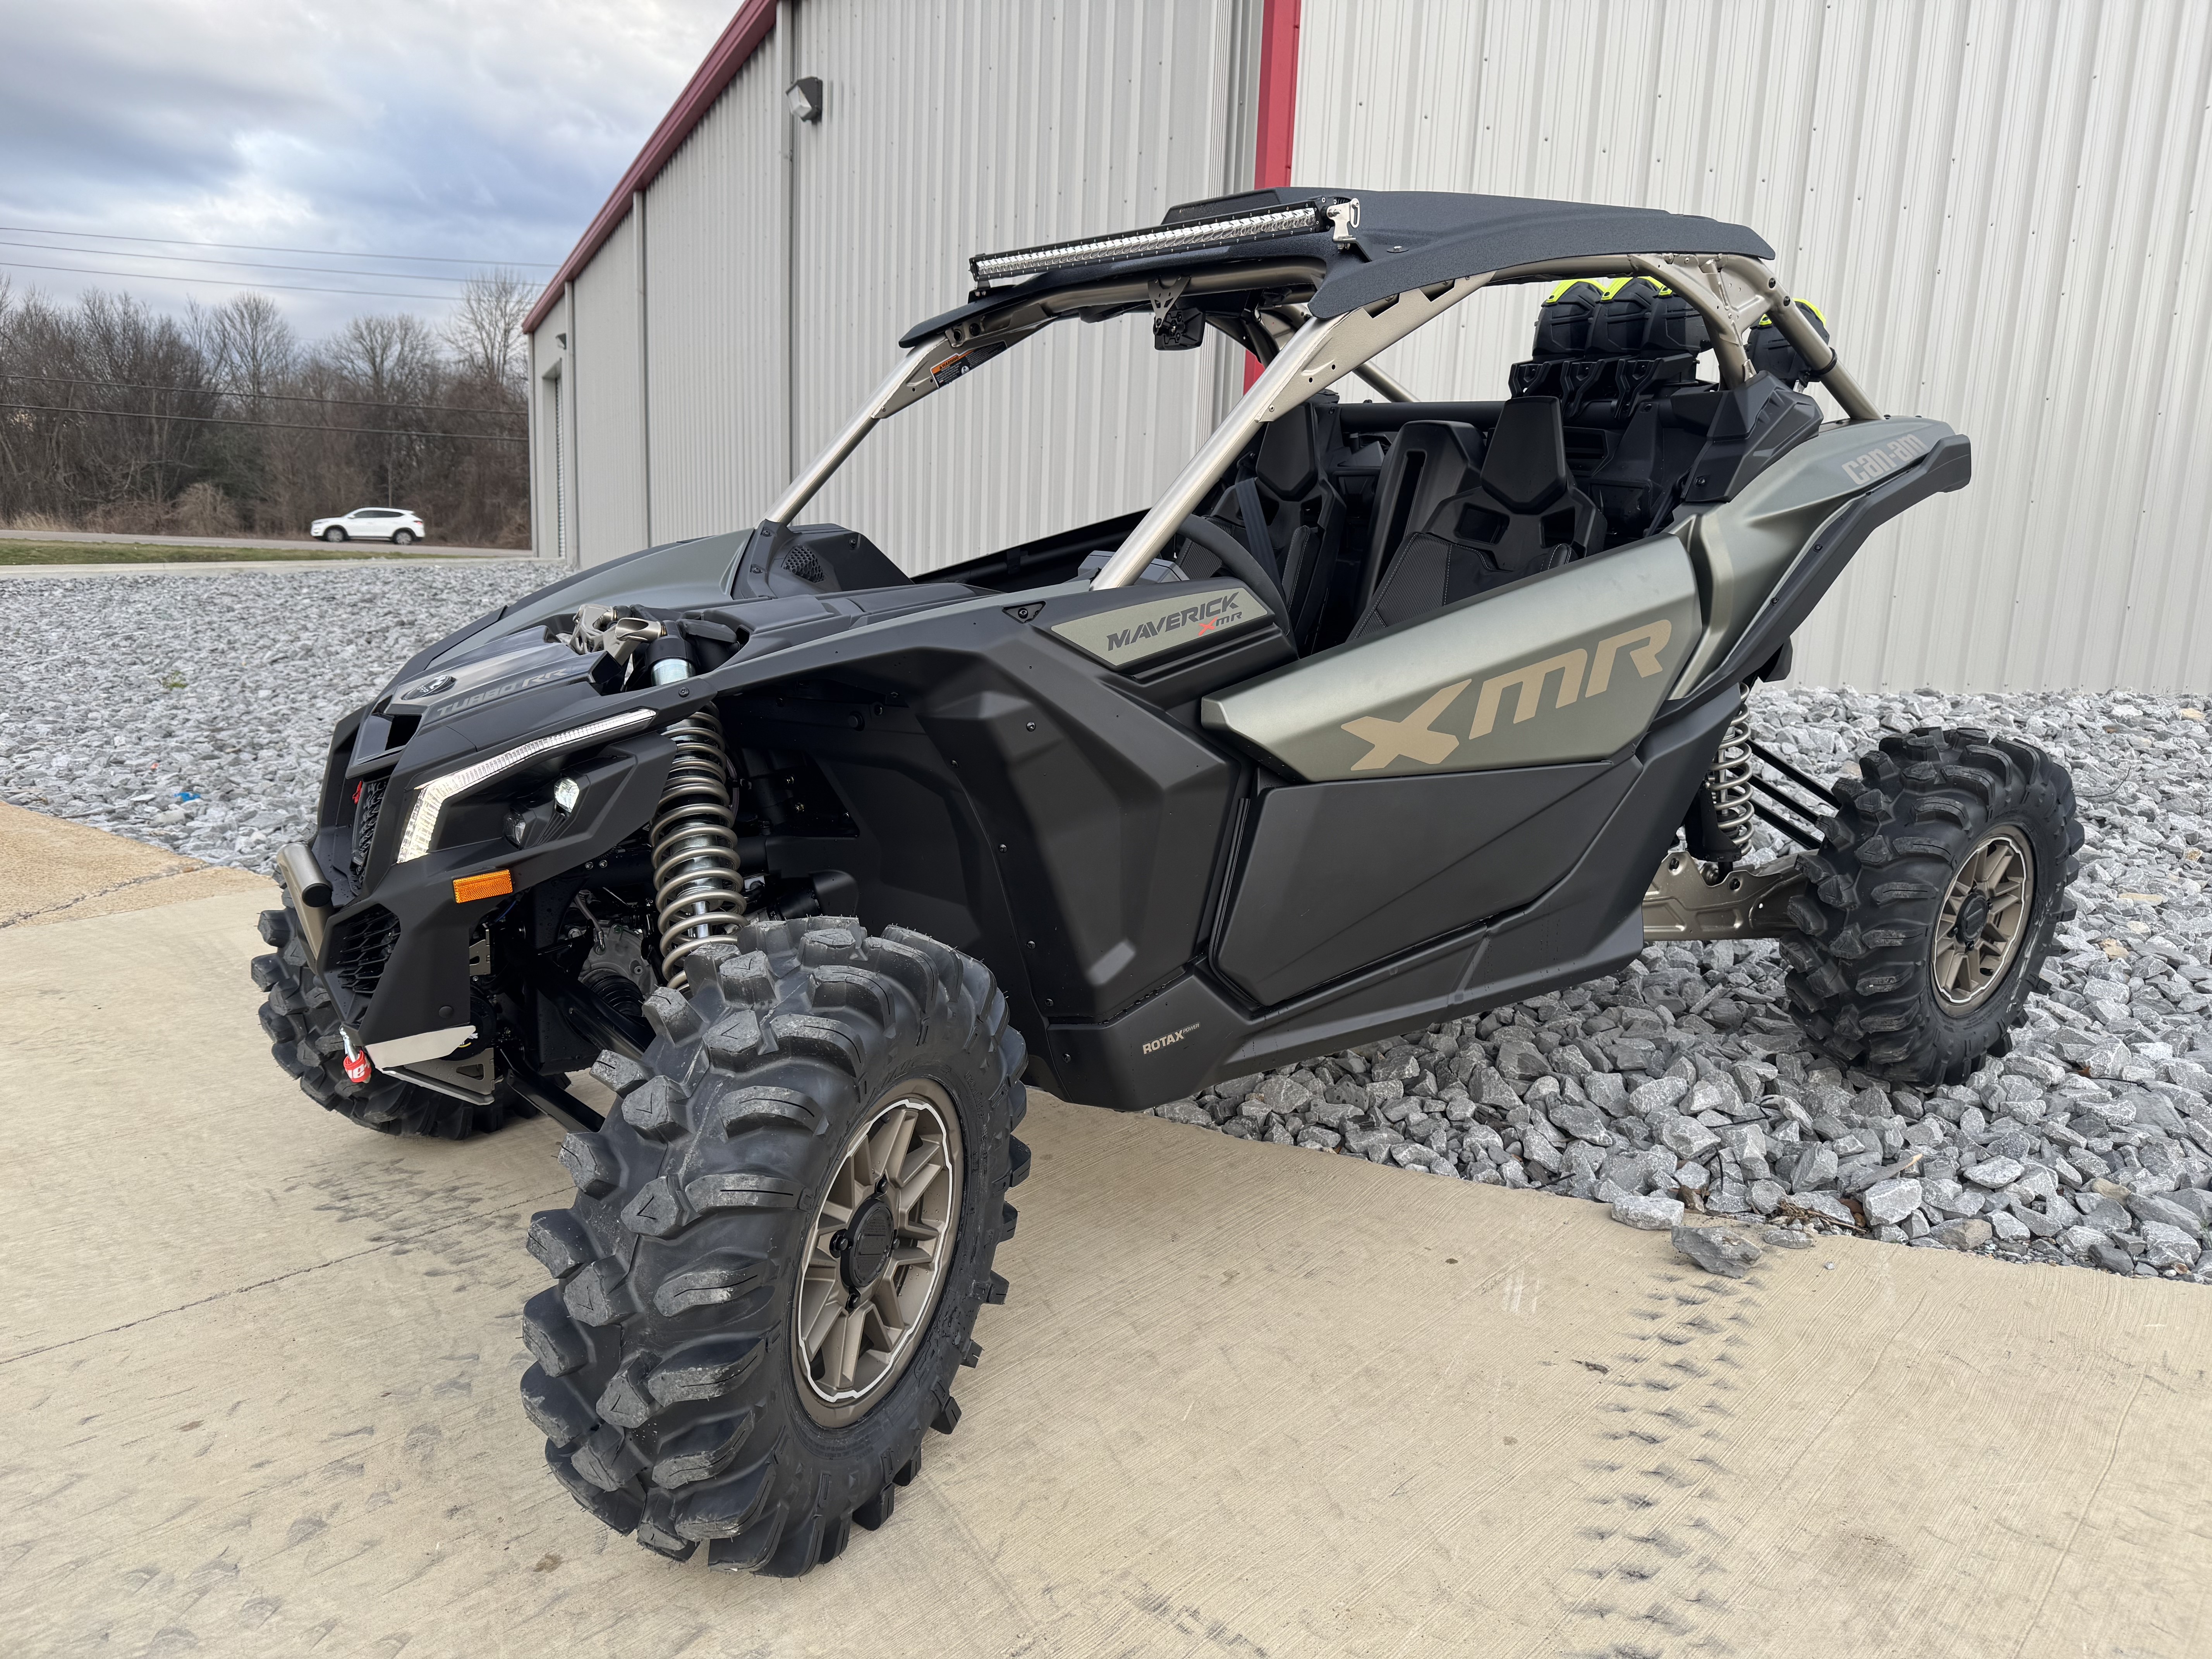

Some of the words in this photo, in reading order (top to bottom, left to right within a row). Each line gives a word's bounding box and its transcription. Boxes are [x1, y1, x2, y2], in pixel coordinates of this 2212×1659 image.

[1106, 591, 1240, 651] MAVERICK
[1142, 1030, 1184, 1054] ROTAX
[1183, 1023, 1199, 1033] POWER
